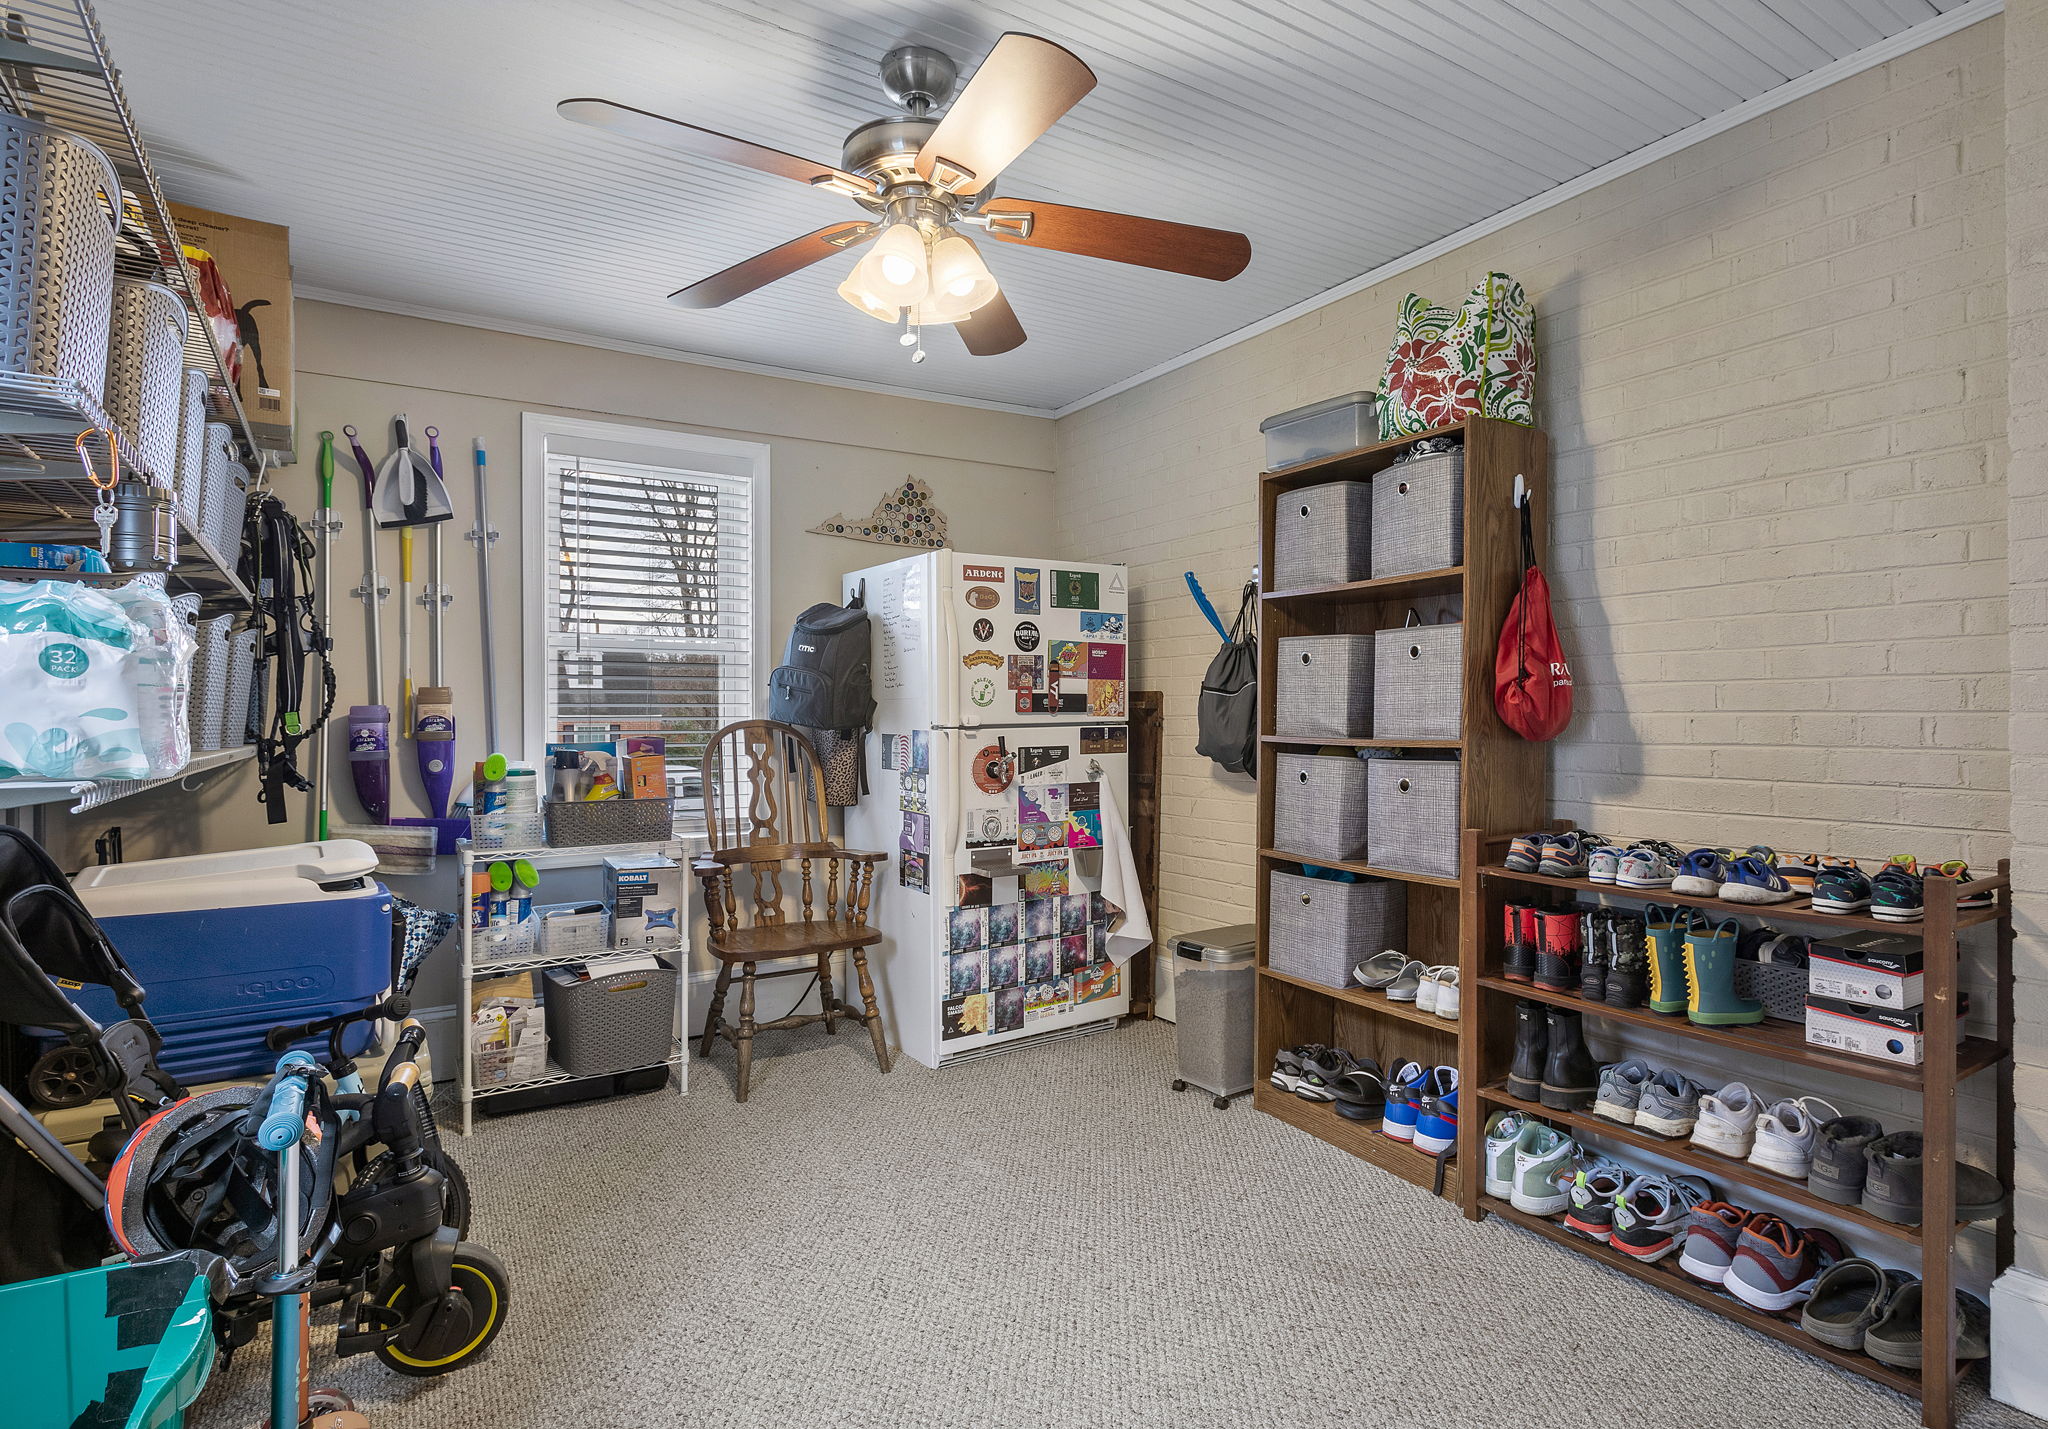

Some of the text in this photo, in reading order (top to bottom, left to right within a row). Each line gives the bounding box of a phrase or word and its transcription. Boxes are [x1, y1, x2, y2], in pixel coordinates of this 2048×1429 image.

[50, 650, 76, 664] 32
[1868, 958, 1894, 966] saucony
[477, 1018, 495, 1026] Safety
[1879, 1015, 1905, 1024] saucony
